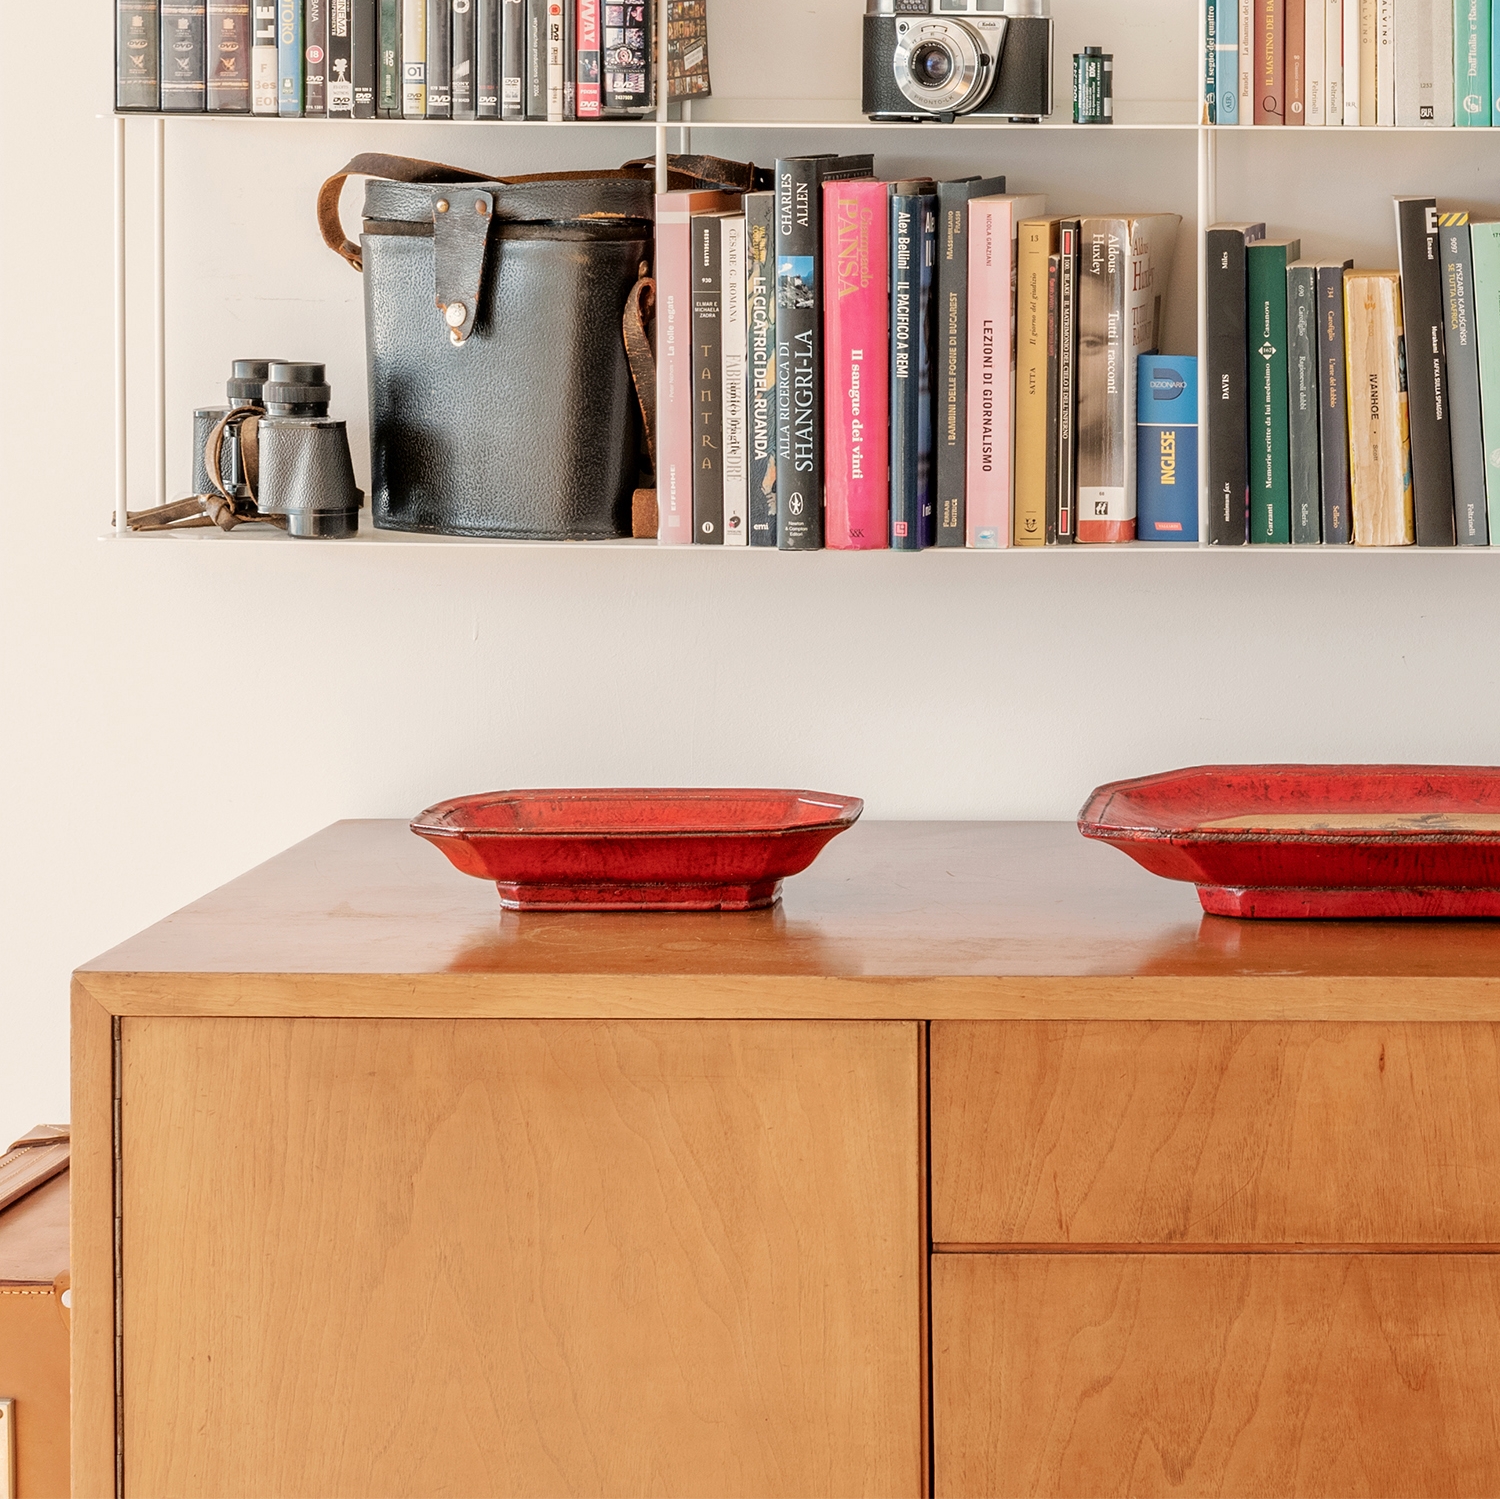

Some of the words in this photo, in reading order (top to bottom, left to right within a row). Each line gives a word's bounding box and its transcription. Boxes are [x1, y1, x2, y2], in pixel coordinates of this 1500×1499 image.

[1265, 15, 1274, 30] DEI
[1265, 32, 1274, 75] MASTINO
[1265, 77, 1274, 86] IL
[837, 196, 859, 300] PANSA
[1090, 233, 1104, 275] Huxley
[1108, 233, 1119, 274] Aldous
[753, 277, 768, 294] LE
[753, 296, 768, 365] CICATRICI
[982, 319, 993, 368] LEZIONI
[1107, 310, 1120, 338] Tutti
[851, 348, 864, 361] Il
[1107, 349, 1119, 394] racconti
[754, 368, 768, 396] DEL
[848, 363, 860, 416] sangue
[982, 372, 993, 385] DI
[754, 399, 768, 460] RUANDA
[851, 418, 864, 443] dei
[981, 389, 993, 472] GIORNALISMO
[851, 445, 864, 480] vinti
